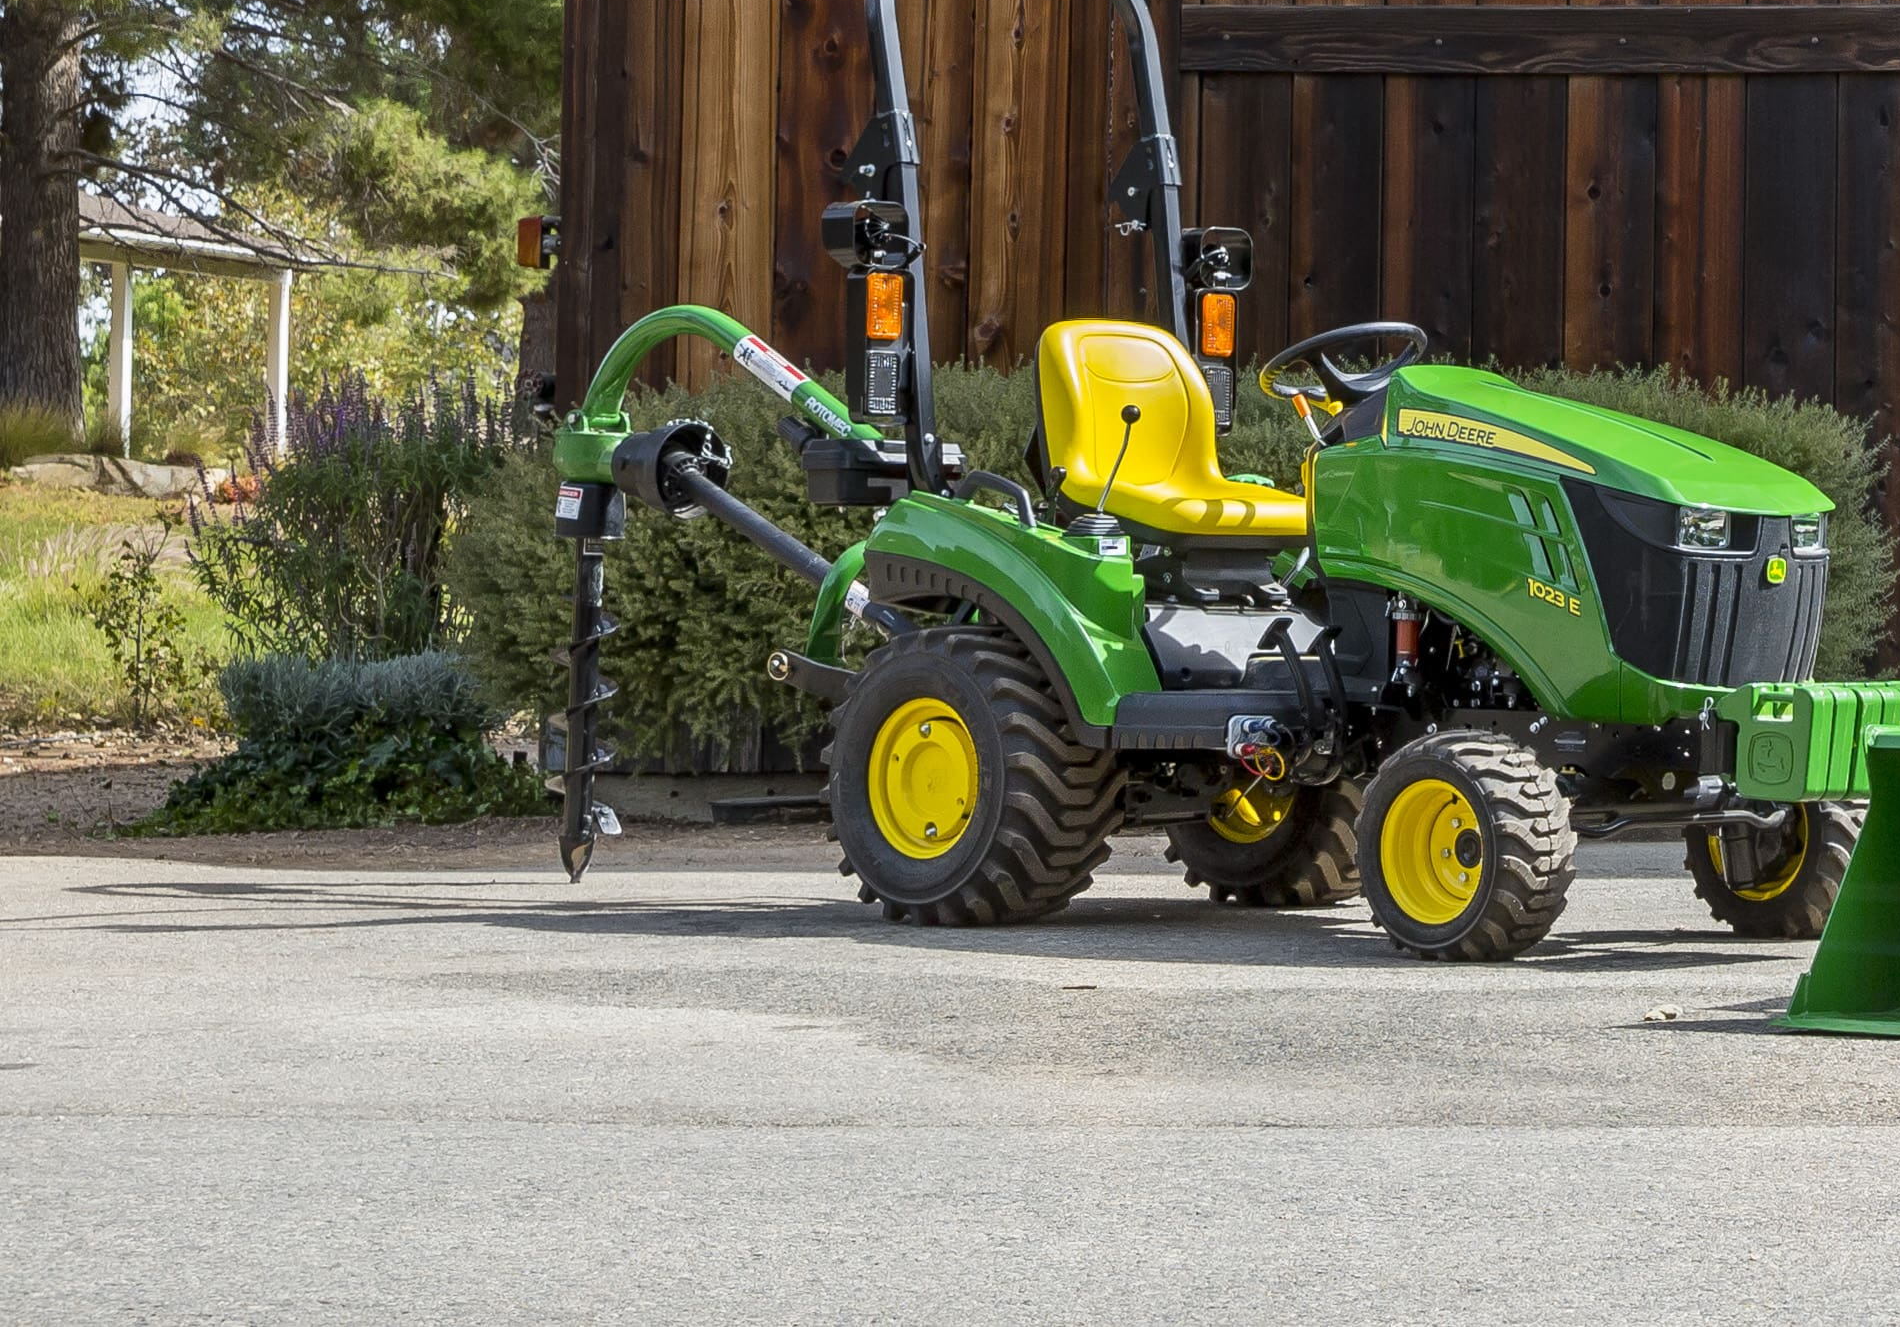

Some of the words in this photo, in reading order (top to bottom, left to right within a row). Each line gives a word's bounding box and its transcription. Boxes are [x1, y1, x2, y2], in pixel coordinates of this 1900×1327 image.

[804, 396, 852, 437] ROTOMEC
[1406, 417, 1446, 438] JOHN
[1447, 421, 1497, 445] DEERE
[1527, 577, 1566, 608] 1023
[1568, 596, 1581, 617] E
